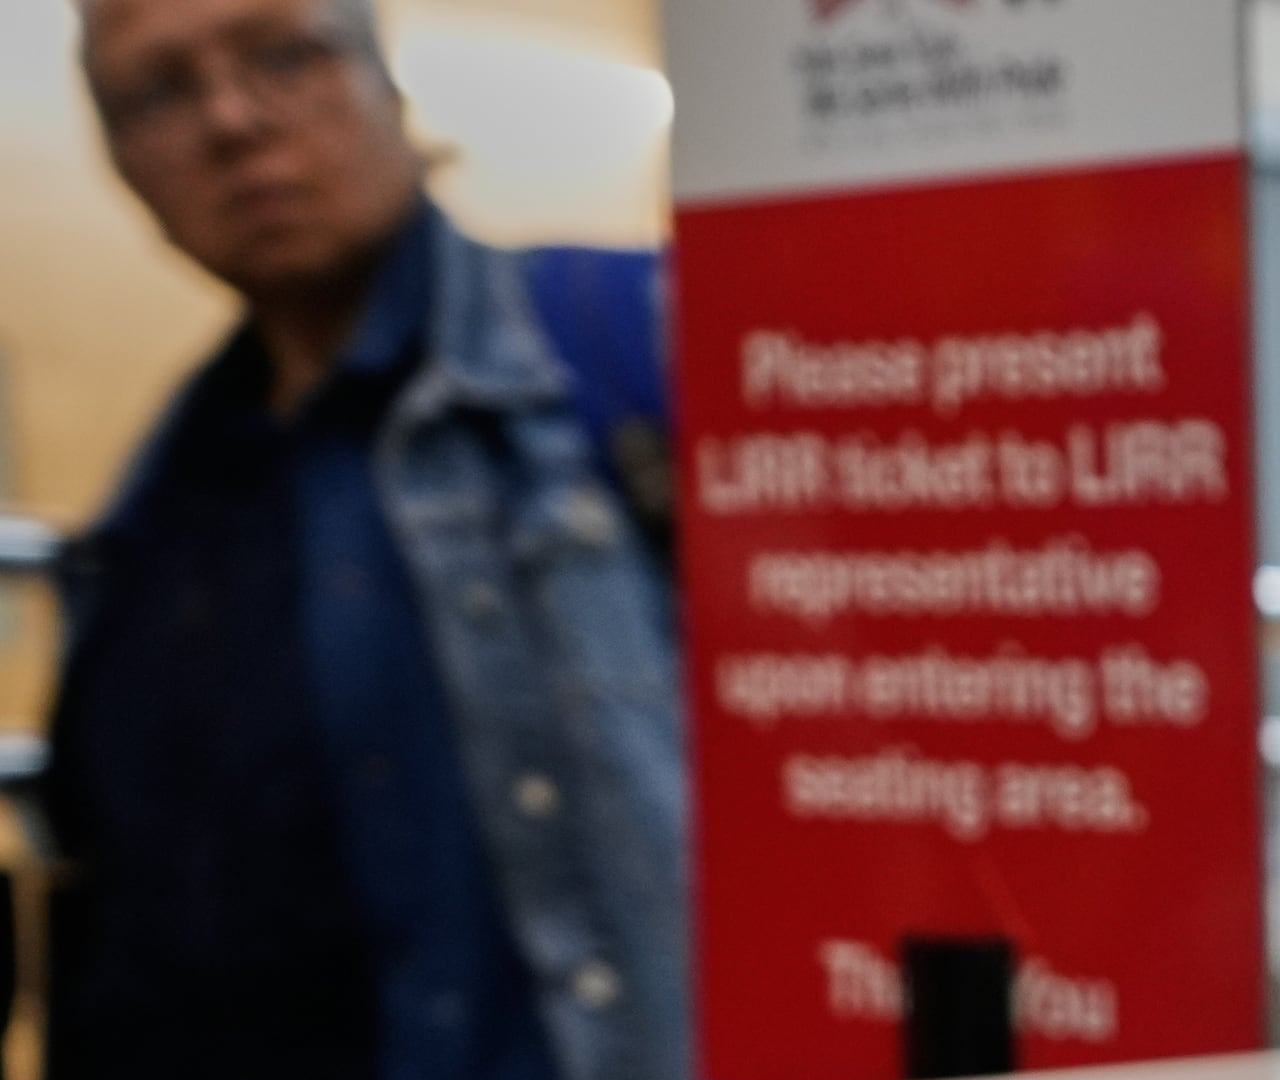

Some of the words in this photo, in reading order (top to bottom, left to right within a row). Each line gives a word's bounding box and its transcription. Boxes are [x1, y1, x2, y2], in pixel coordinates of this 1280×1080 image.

[743, 332, 923, 406] Please
[931, 316, 1162, 411] present
[699, 434, 828, 512] LIRR
[836, 436, 990, 506] ticket
[999, 436, 1061, 503] to
[1069, 420, 1226, 502] LIRR
[749, 540, 1157, 624] representative
[719, 653, 849, 727] upon
[861, 650, 1094, 738] entering
[1100, 648, 1207, 723] the
[784, 748, 985, 841] seating
[996, 763, 1146, 834] area.
